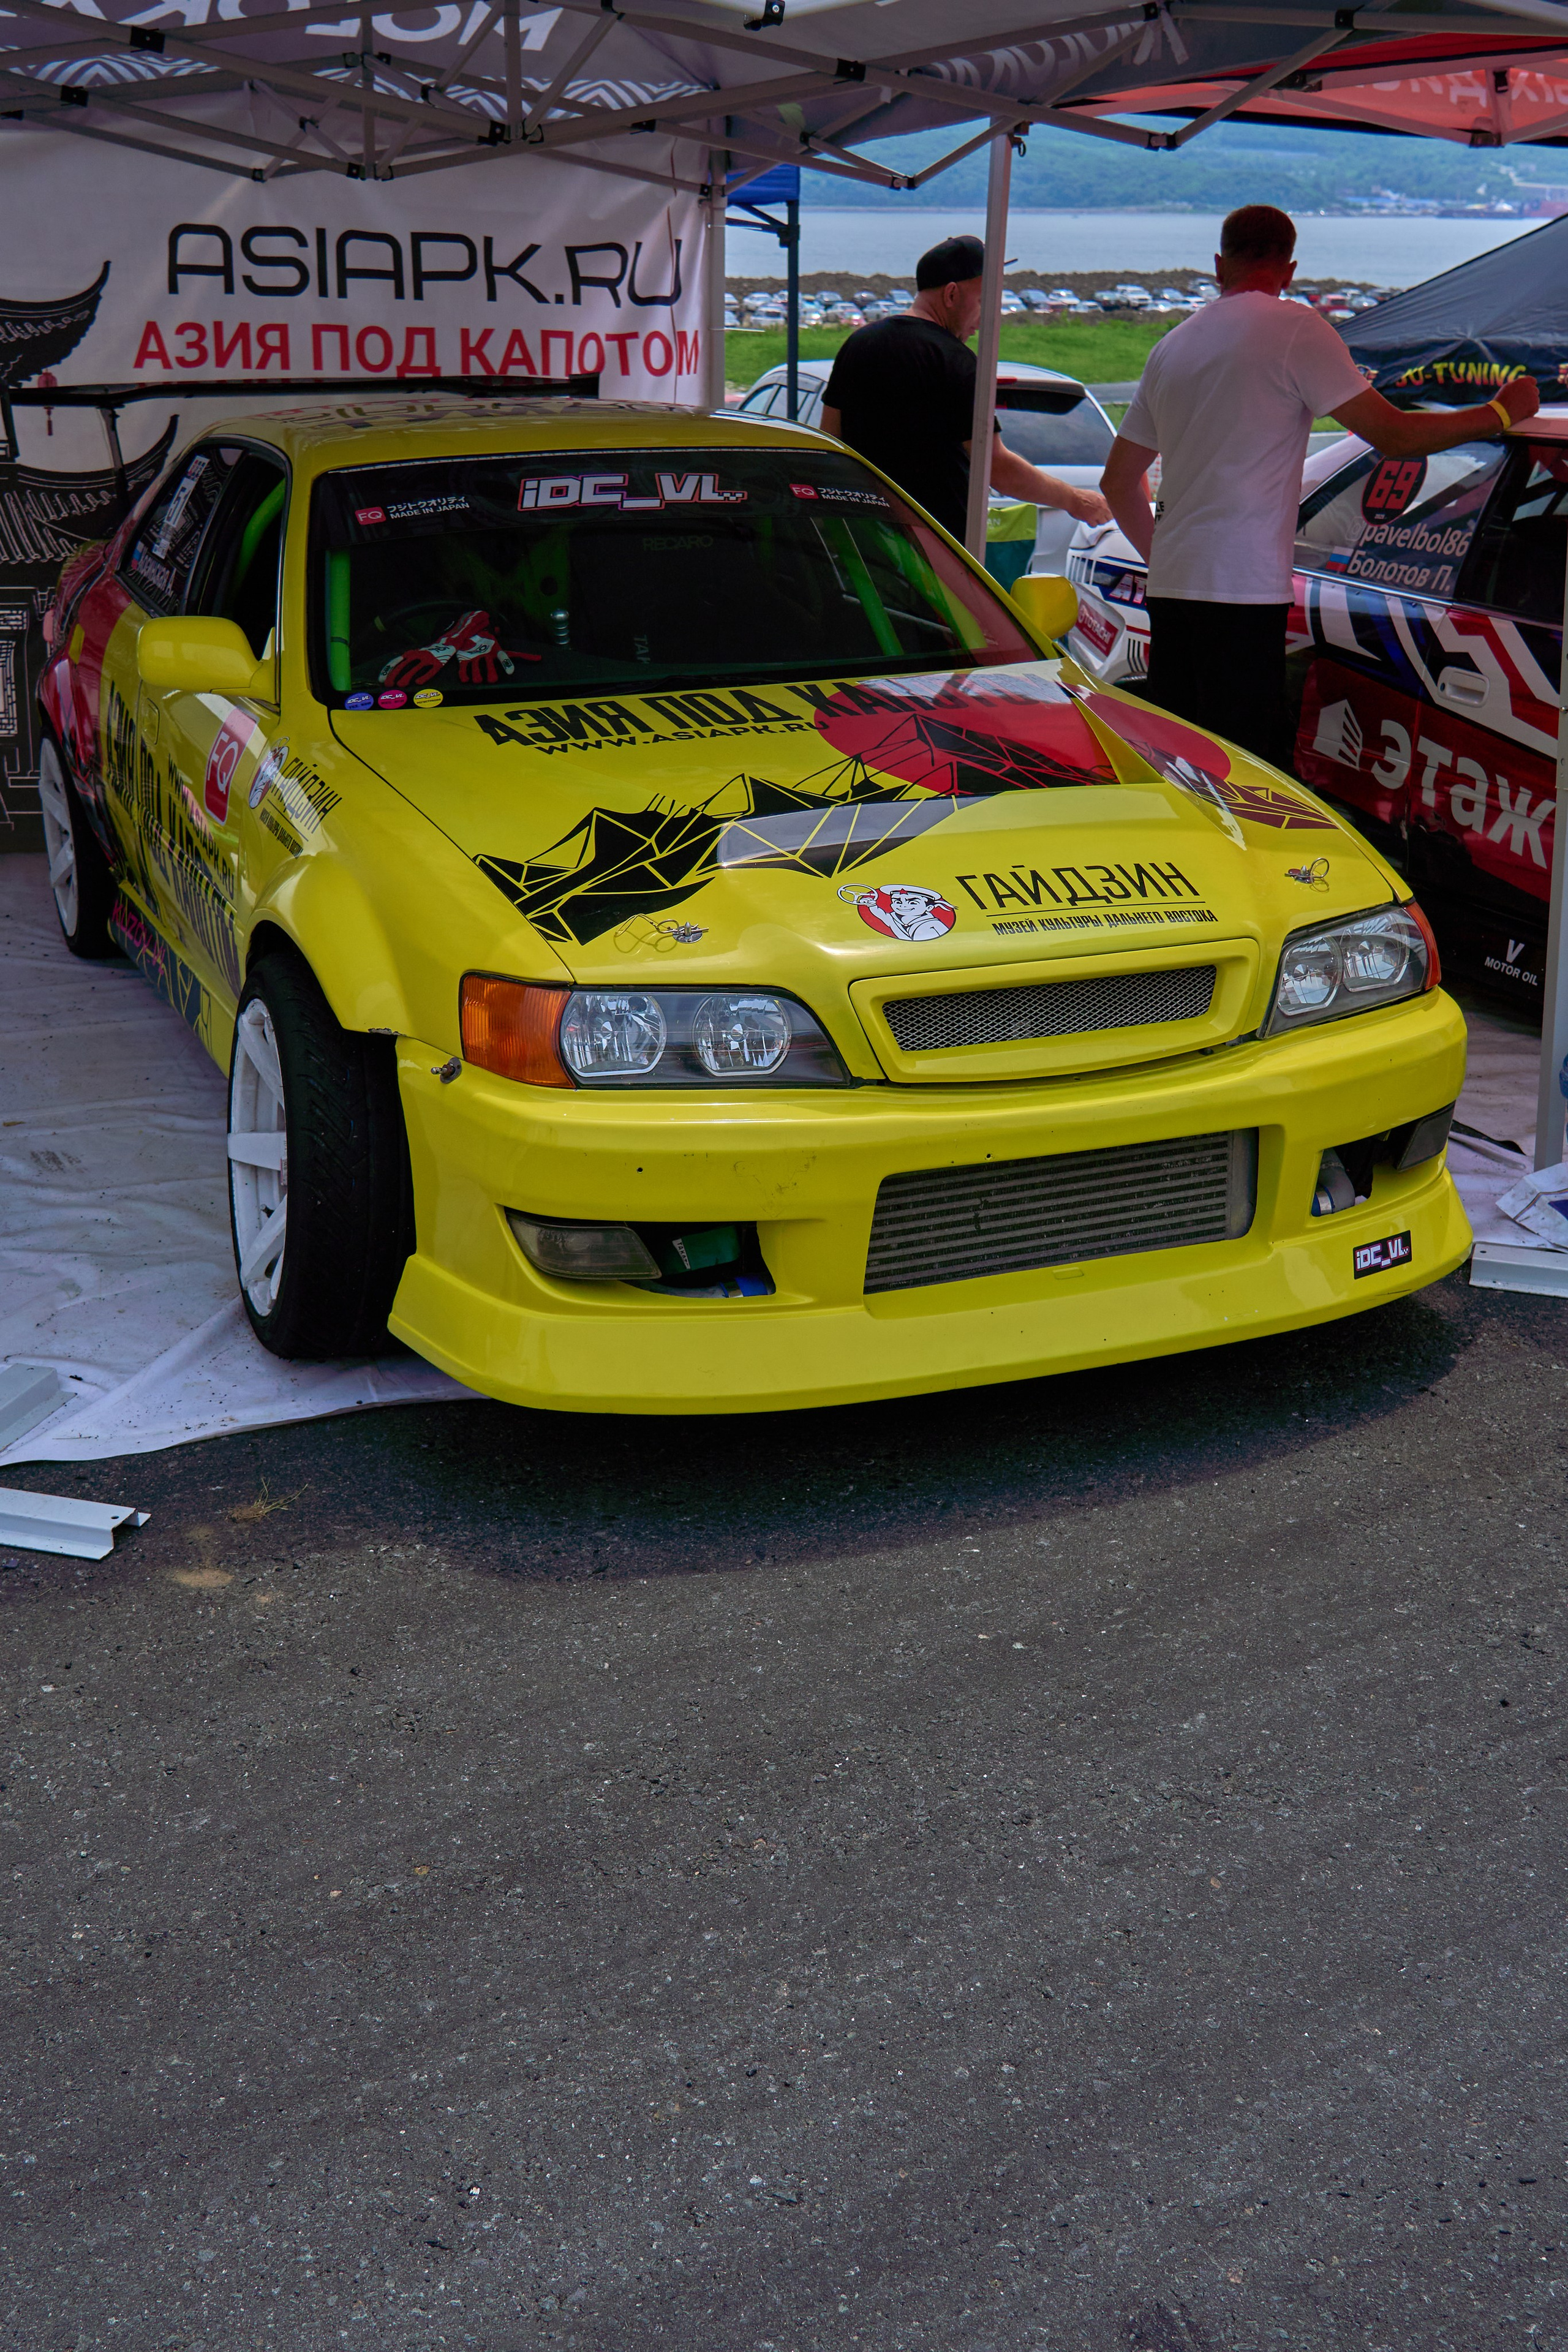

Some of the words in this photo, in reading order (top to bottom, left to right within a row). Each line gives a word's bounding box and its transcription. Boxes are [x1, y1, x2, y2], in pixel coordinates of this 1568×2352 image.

[168, 223, 682, 308] ASIAPK.RU
[133, 320, 289, 370] АЗИЯ
[312, 324, 441, 378] ПОД
[460, 328, 701, 377] КАПОТОМ
[792, 487, 815, 496] FQ
[1366, 460, 1423, 510] 69
[357, 510, 383, 522] FQ
[386, 496, 466, 513] フジトクオリティ
[389, 509, 422, 520] MADE
[436, 502, 470, 513] JAPAN
[862, 498, 891, 508] JAPAN
[643, 535, 714, 551] RECARO
[1359, 522, 1473, 557] pavelbol86
[1347, 549, 1431, 587] Болотов
[1430, 564, 1453, 592] П.
[473, 701, 652, 747] АЗИЯ
[647, 688, 804, 729] ПОД
[207, 731, 239, 795] FQ
[271, 757, 342, 834] ГАЙДЗИН
[954, 862, 1200, 910] ГАЙДЗИН
[991, 918, 1038, 935] МУЗЕЙ
[1038, 914, 1104, 932] КУЛЬТУРЫ
[1103, 911, 1166, 929] ДАЛЬНЕГО
[1164, 909, 1219, 923] ВОСТОКА
[1483, 956, 1521, 979] MOTOR
[1521, 970, 1539, 986] OIL
